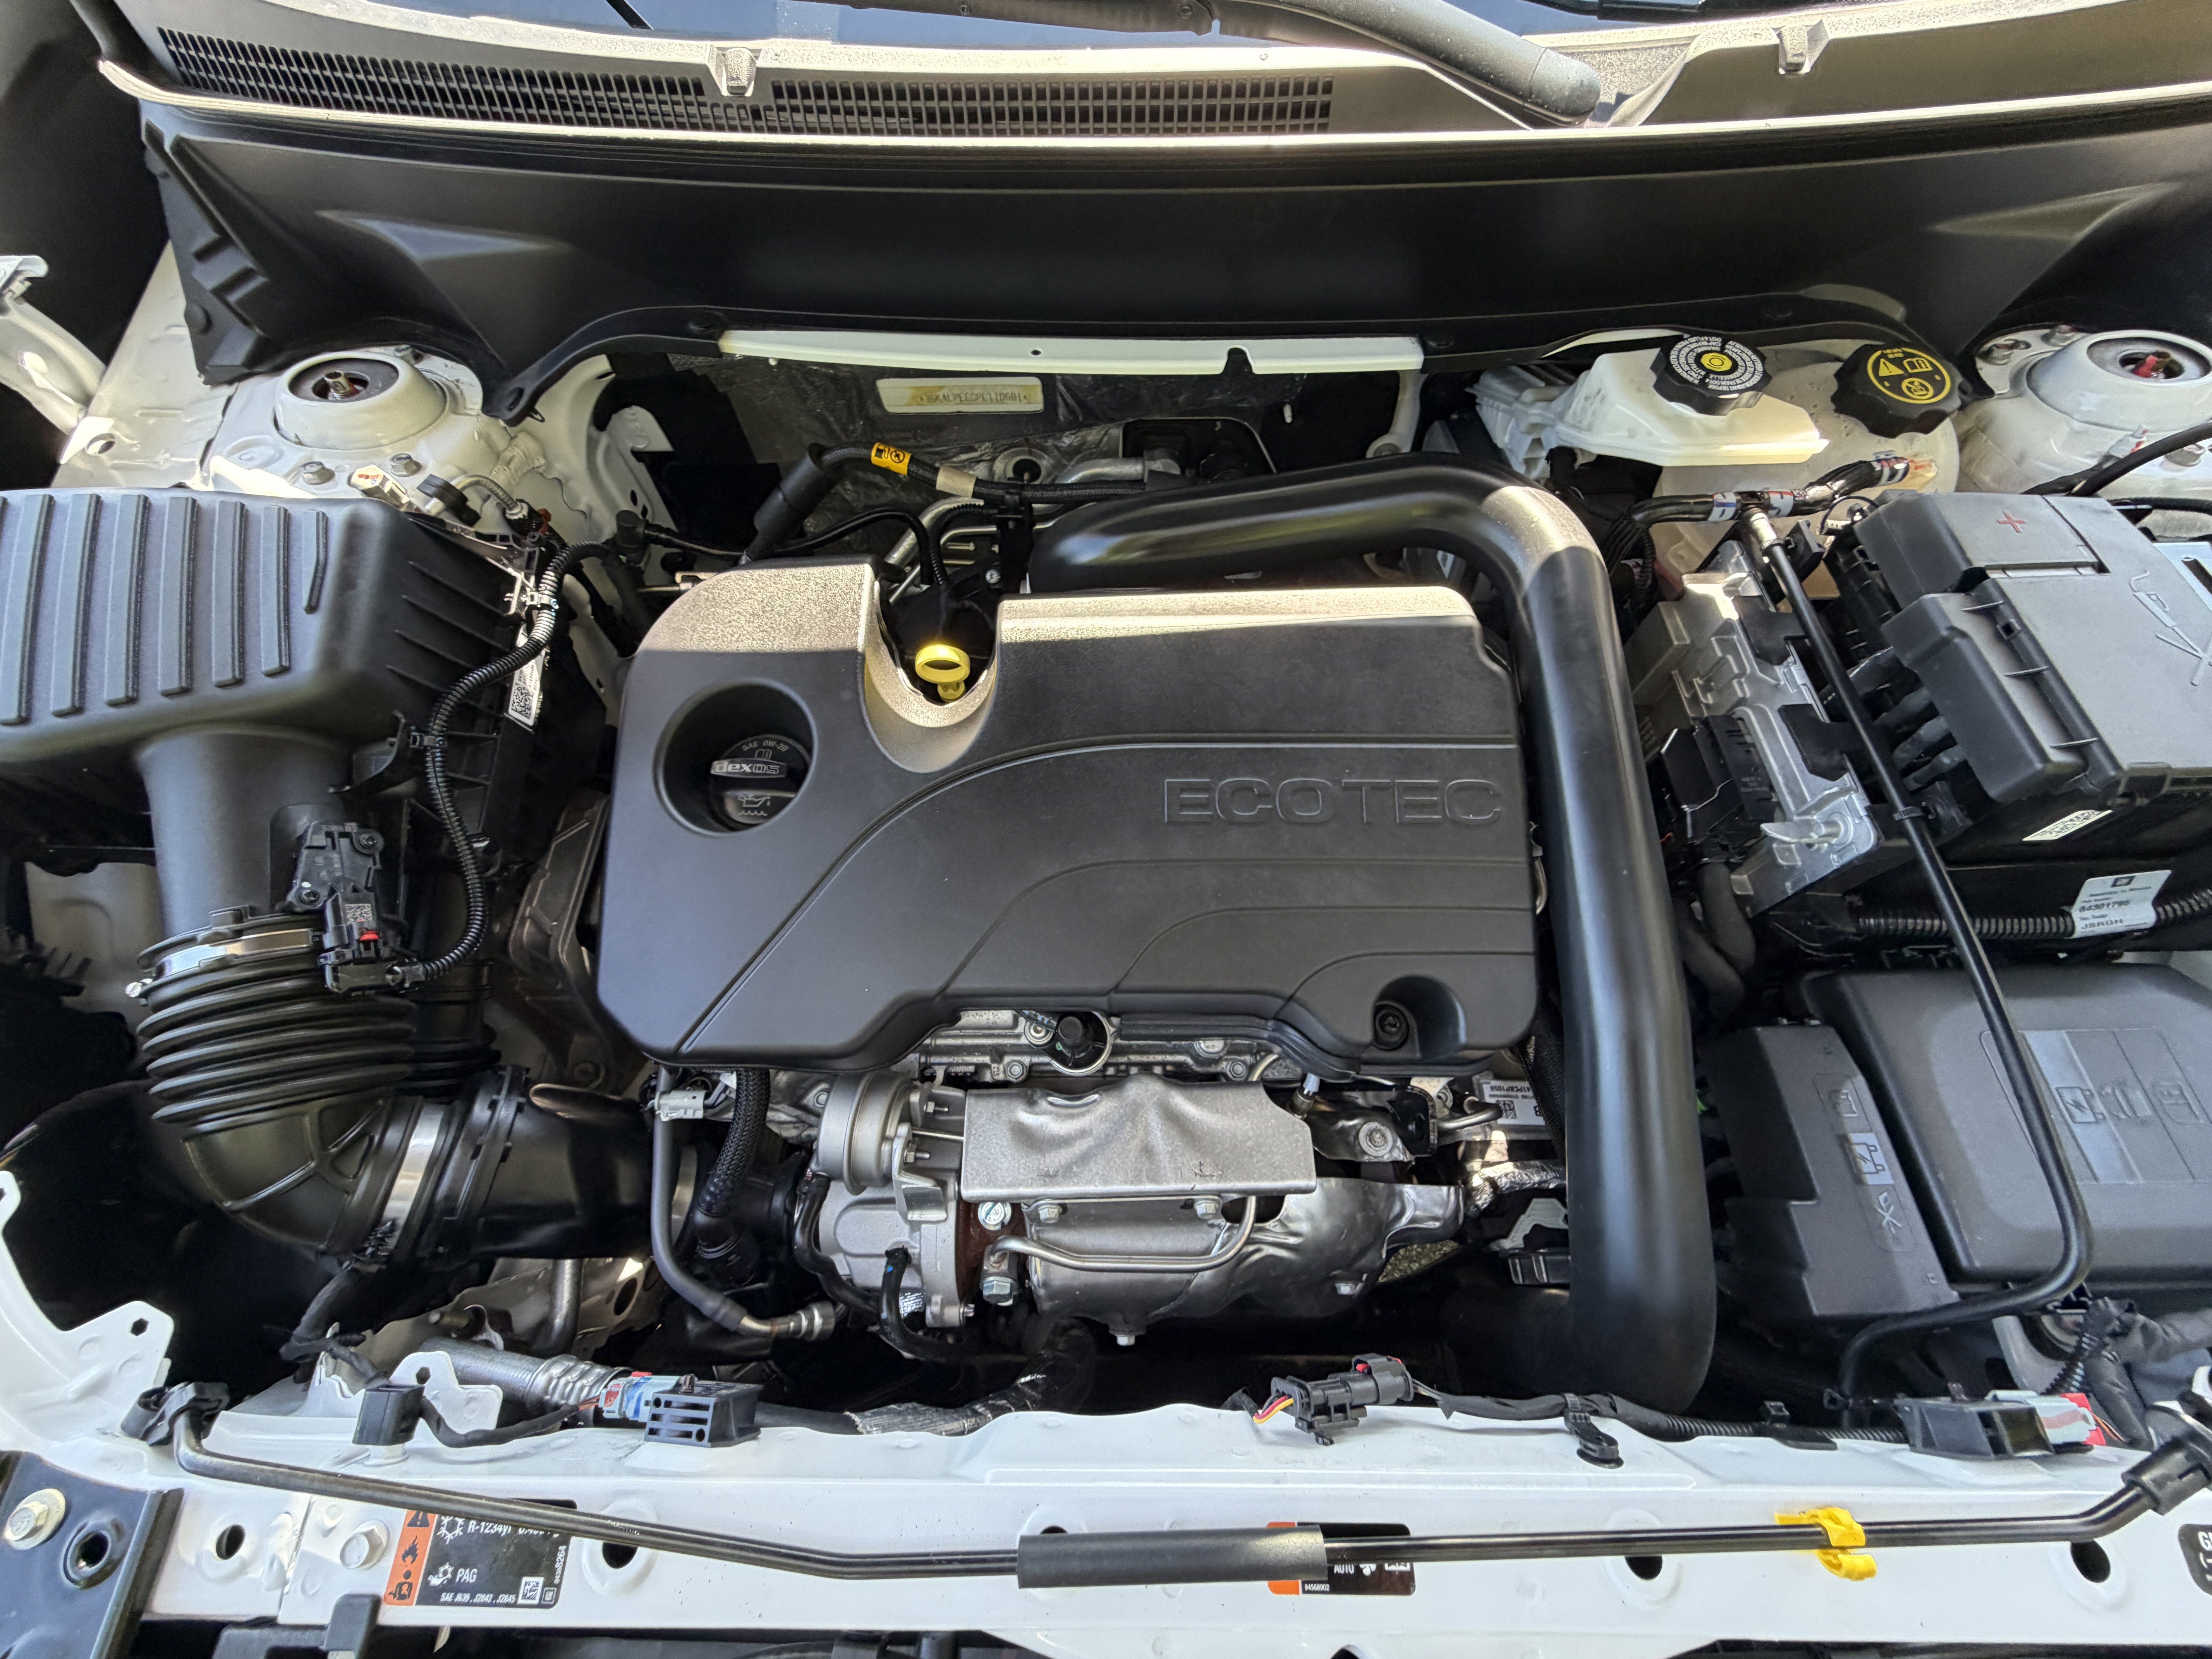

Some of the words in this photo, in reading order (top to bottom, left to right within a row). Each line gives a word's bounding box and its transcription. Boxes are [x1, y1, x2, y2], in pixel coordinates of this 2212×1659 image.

[742, 741, 759, 752] SAE
[763, 740, 789, 752] 0W-20
[1163, 778, 1502, 826] ECOTEC
[455, 1568, 478, 1583] PAG
[440, 1592, 454, 1602] SAE
